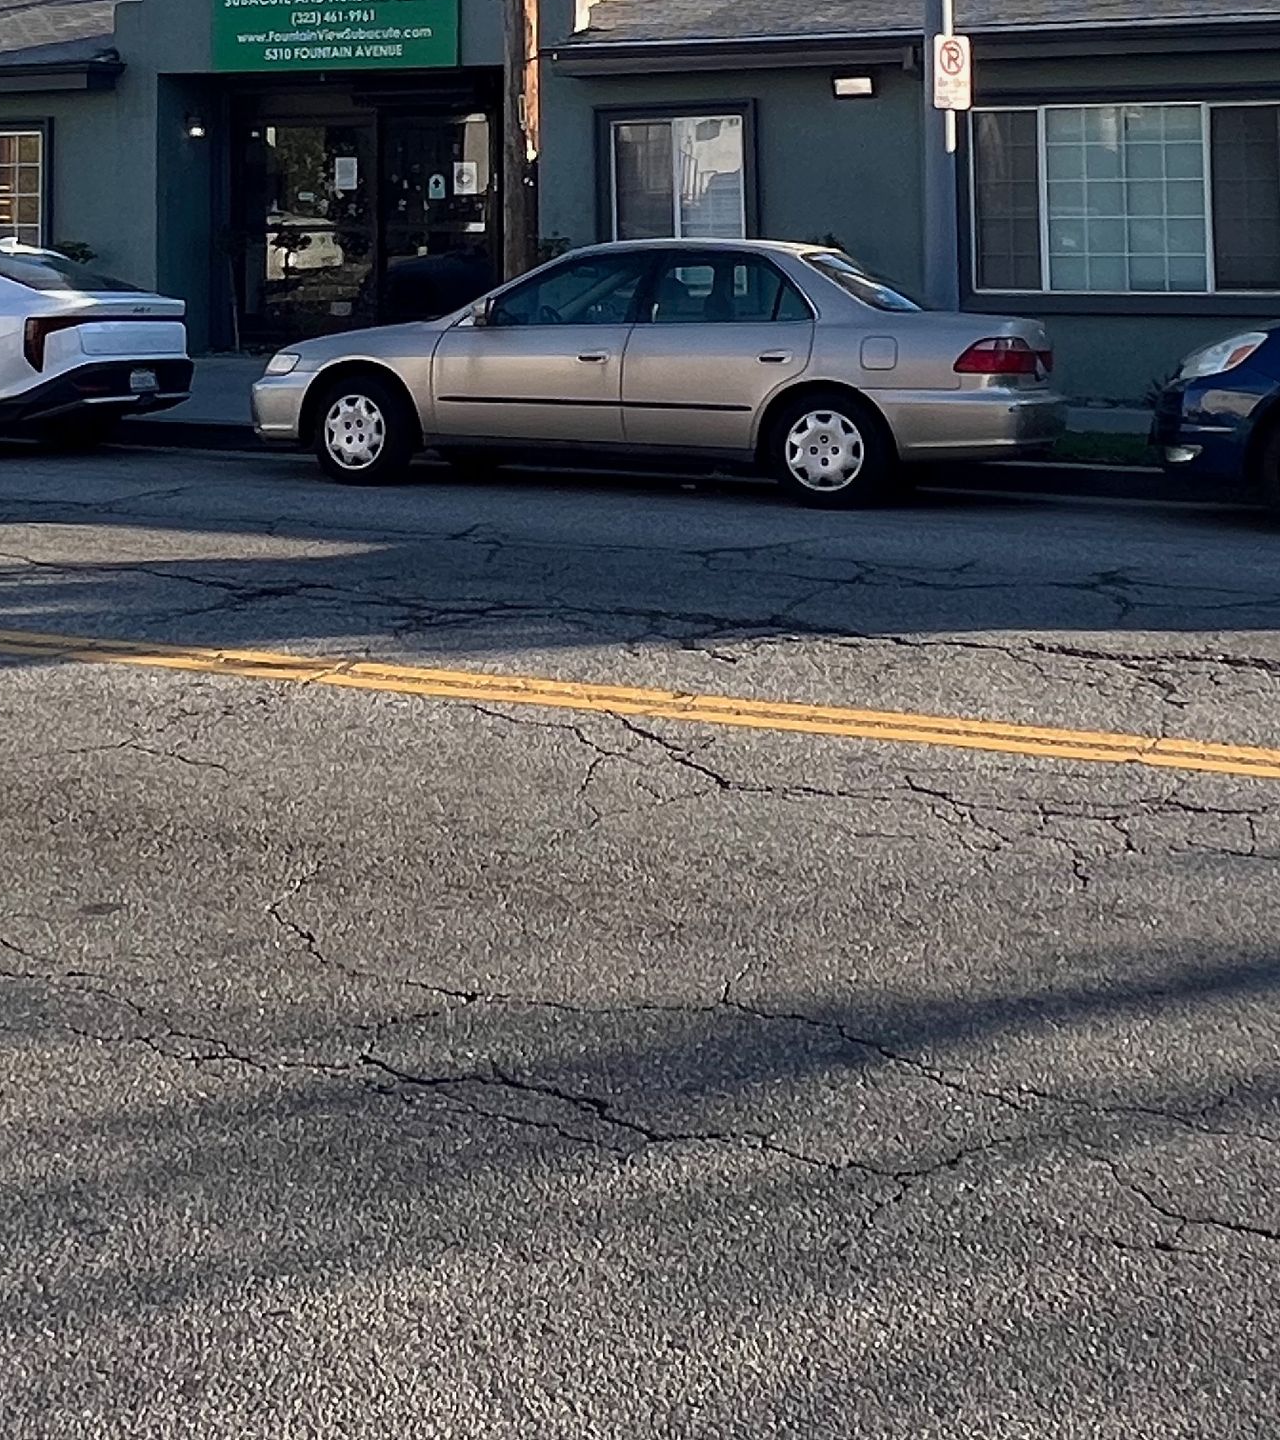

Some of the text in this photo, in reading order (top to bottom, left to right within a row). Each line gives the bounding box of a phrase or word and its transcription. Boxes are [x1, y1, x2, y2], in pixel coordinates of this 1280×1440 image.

[291, 11, 321, 27] (323)
[293, 45, 353, 59] FOUNTAIN
[354, 44, 403, 58] AVENUE
